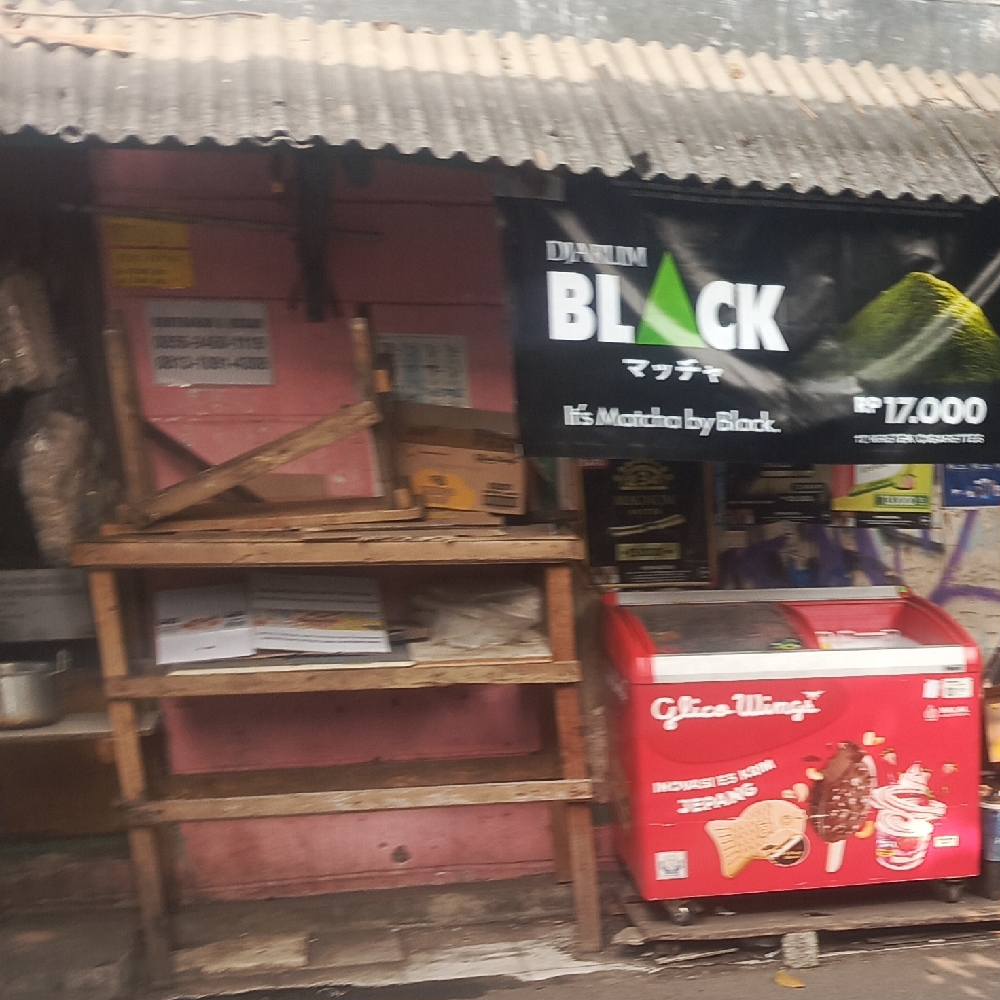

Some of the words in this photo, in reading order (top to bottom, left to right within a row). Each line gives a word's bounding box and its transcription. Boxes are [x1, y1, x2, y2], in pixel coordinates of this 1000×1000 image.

[546, 270, 790, 351] BLACK
[621, 357, 725, 384] マッチャ
[595, 406, 683, 429] Matcha
[684, 408, 715, 436] by
[882, 396, 988, 425] 17.000
[651, 695, 731, 731] Glico
